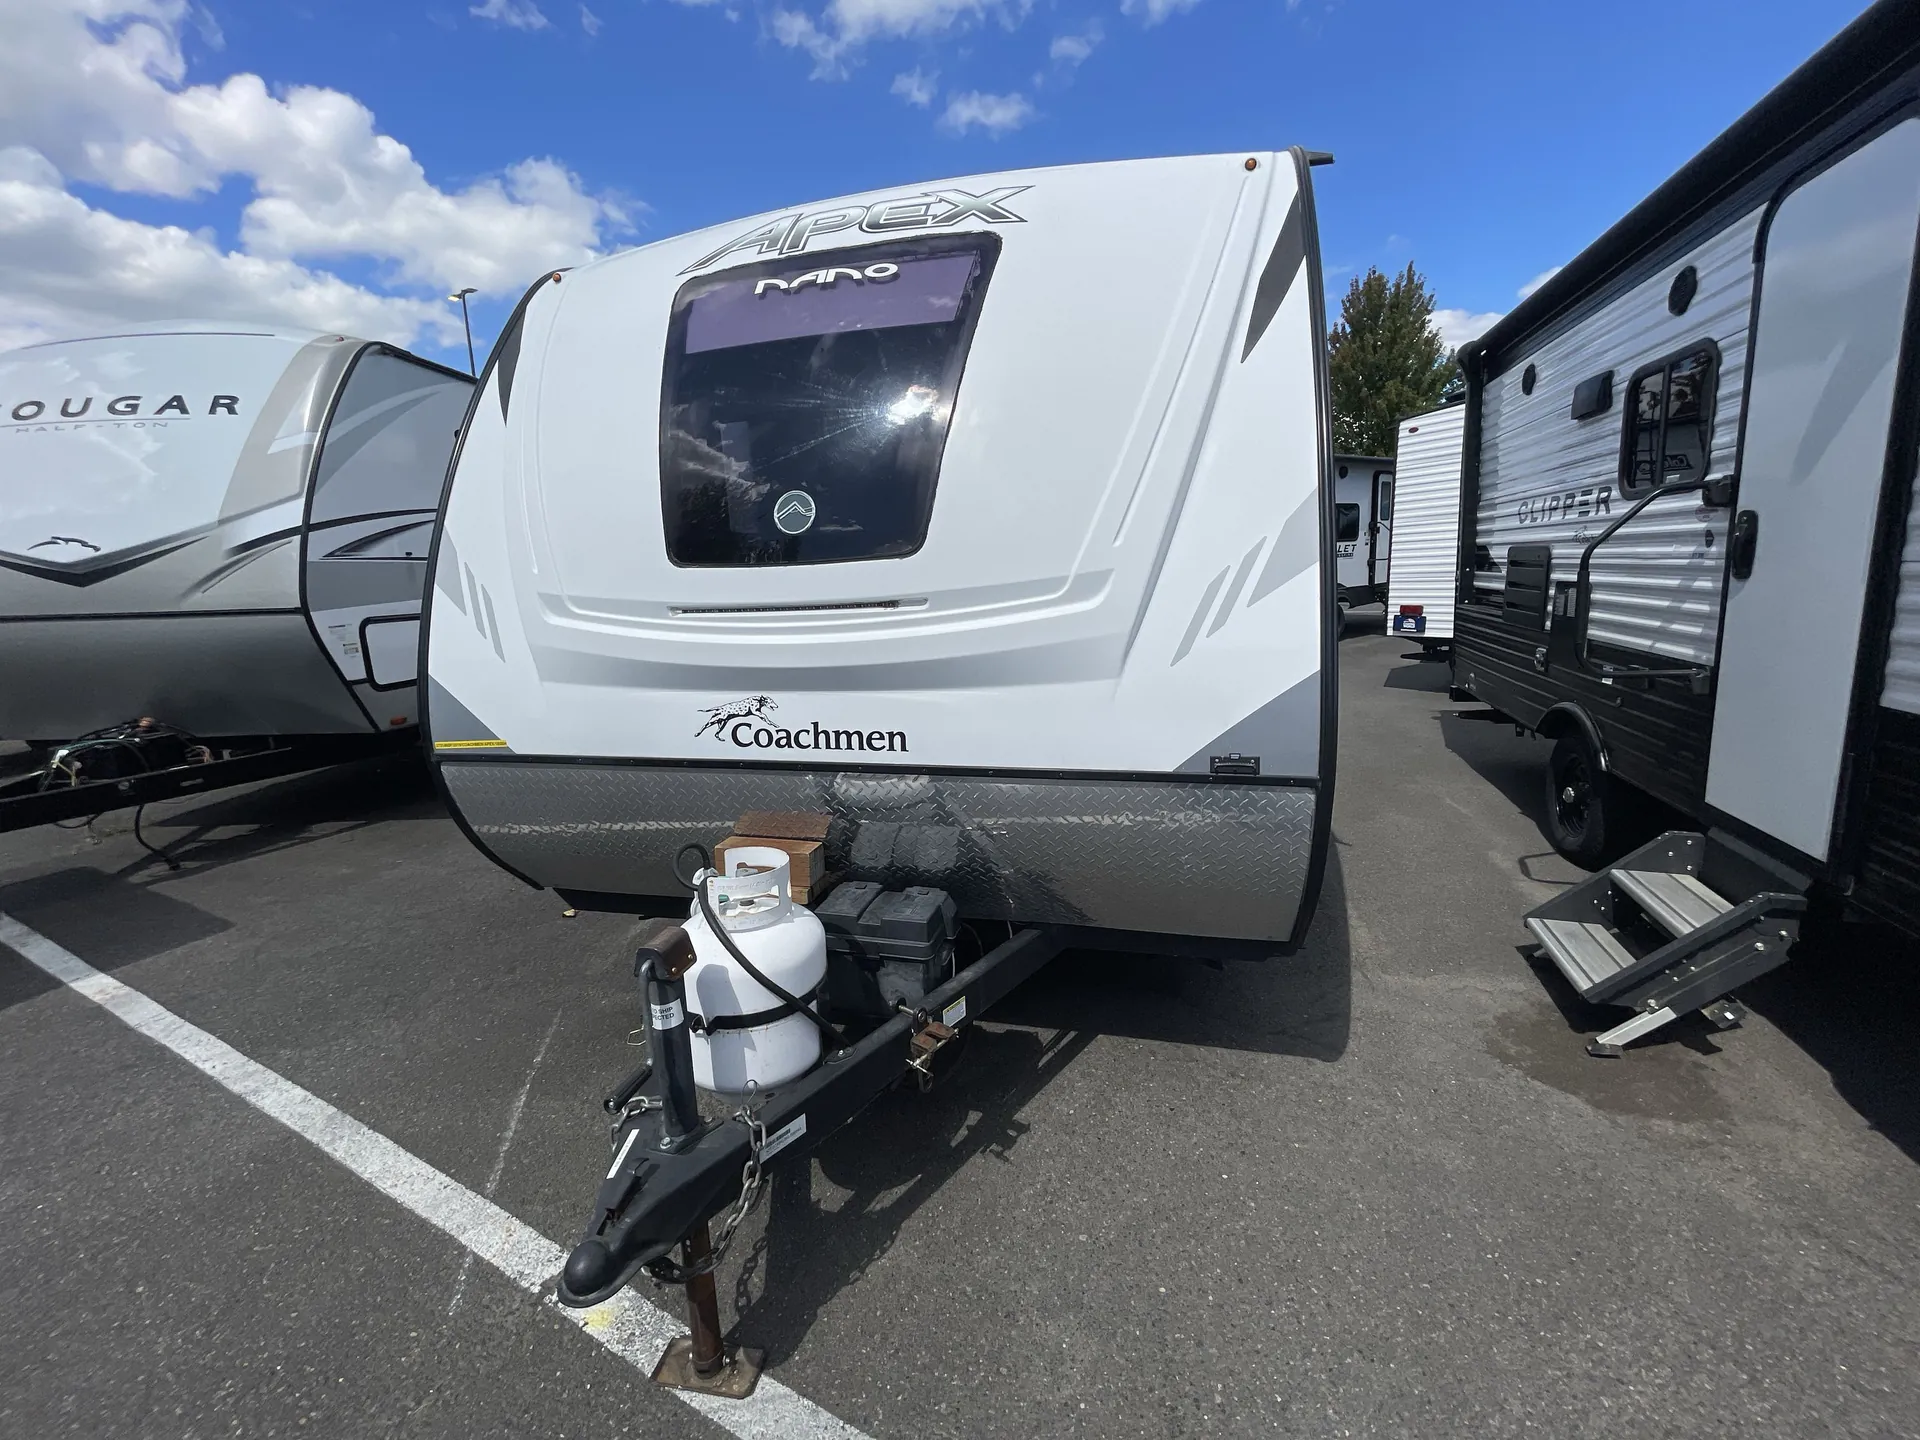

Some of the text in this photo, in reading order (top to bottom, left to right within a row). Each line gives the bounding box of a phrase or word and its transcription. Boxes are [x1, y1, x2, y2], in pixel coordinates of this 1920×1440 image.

[676, 185, 1036, 276] APEX
[0, 394, 240, 421] OUGAR
[1518, 486, 1612, 524] CLIPPER
[1337, 544, 1357, 553] LET
[731, 721, 909, 752] Coachmen
